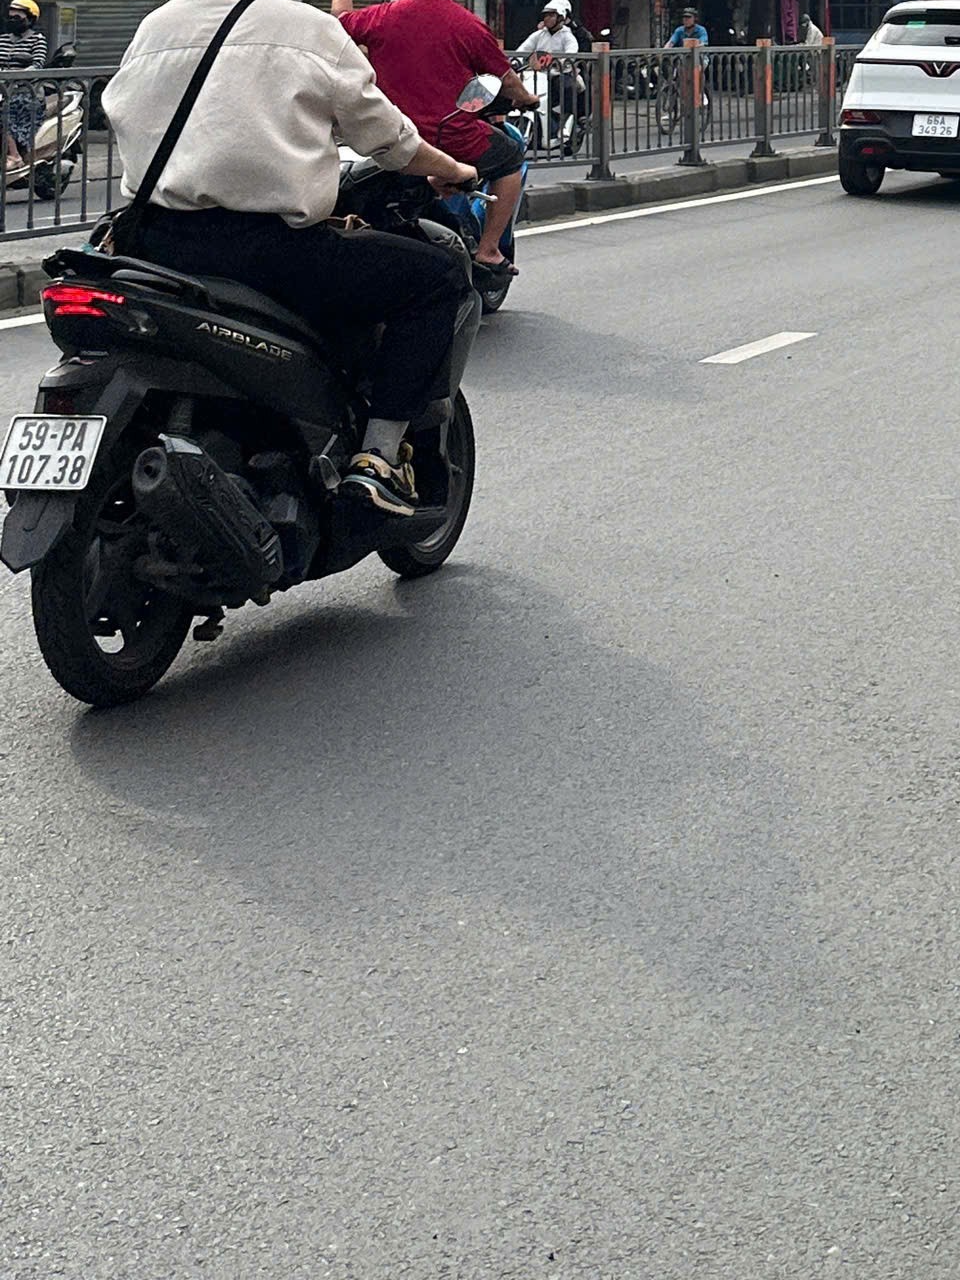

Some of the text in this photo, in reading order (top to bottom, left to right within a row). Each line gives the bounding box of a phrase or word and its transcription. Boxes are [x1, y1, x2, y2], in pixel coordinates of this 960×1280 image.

[194, 322, 293, 360] AIRBLADE
[18, 421, 88, 451] 59-PA
[6, 454, 86, 485] 107.38
